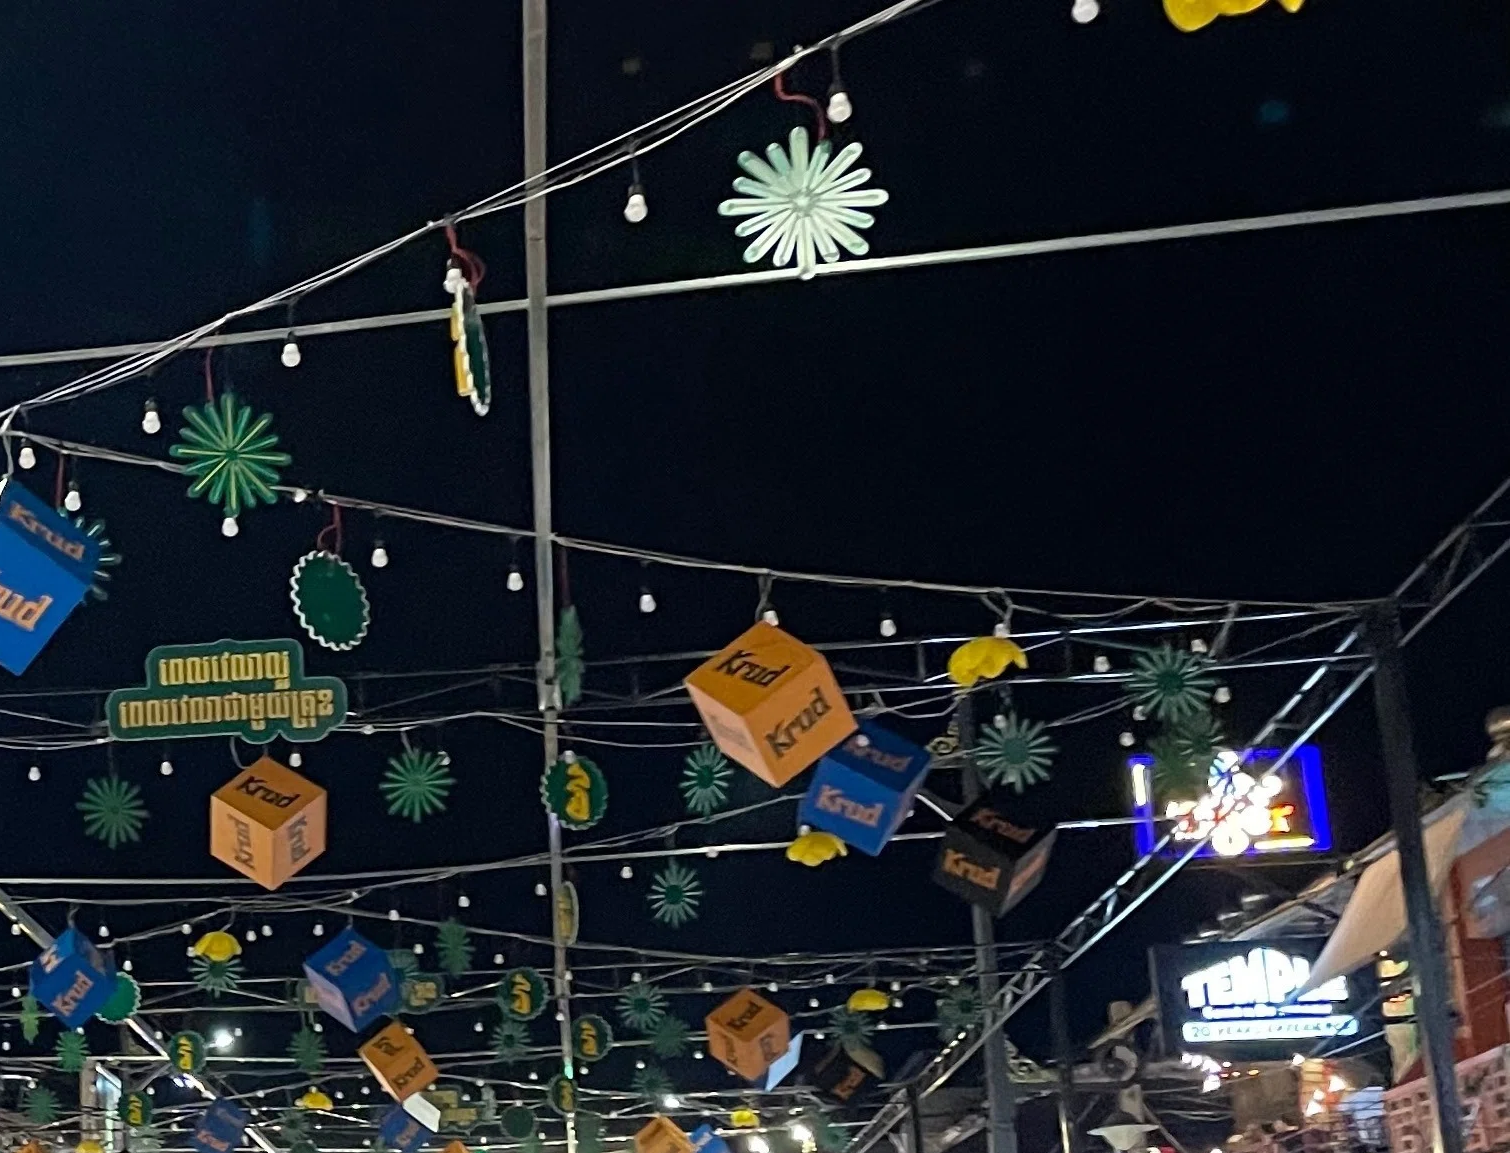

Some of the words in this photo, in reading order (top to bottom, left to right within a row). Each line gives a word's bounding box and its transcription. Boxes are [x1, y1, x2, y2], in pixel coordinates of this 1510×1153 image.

[7, 501, 85, 562] Krud
[715, 649, 792, 688] Krud
[765, 686, 833, 759] Krud
[237, 775, 301, 809] Krud
[815, 784, 885, 828] Krud
[227, 812, 256, 871] Krud
[287, 815, 313, 864] Krud
[942, 848, 1002, 890] Krud
[51, 968, 95, 1018] Krud
